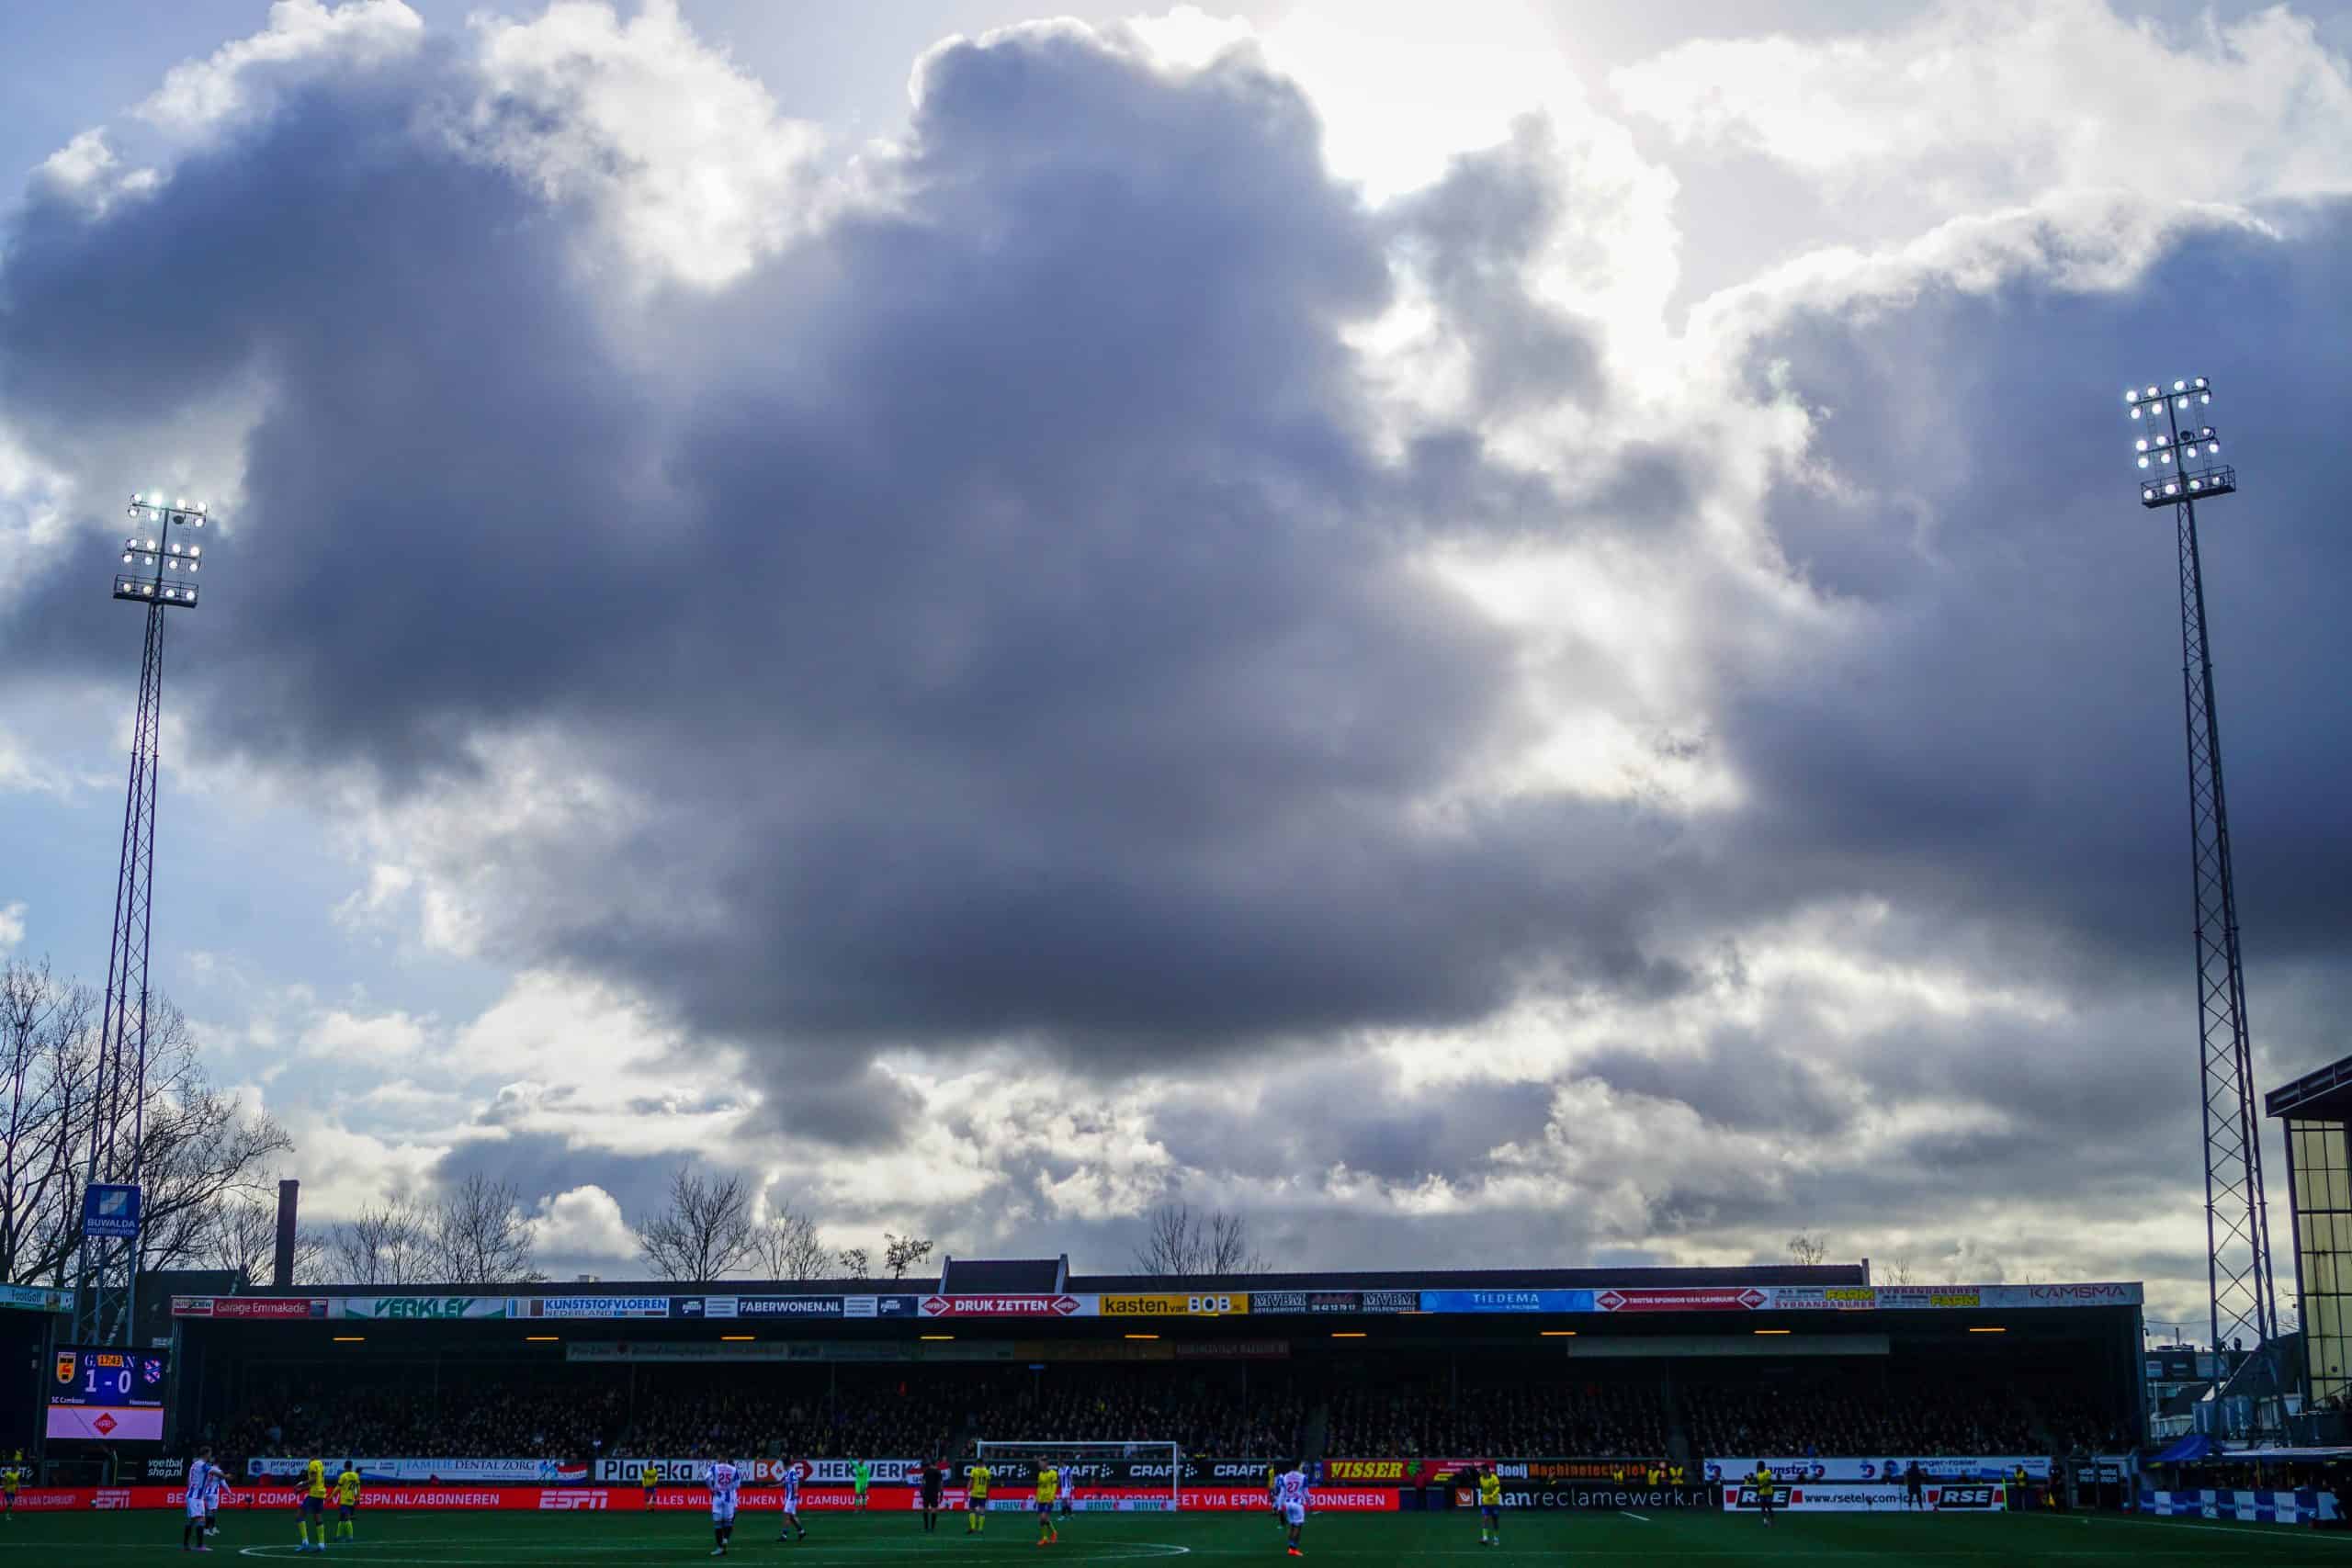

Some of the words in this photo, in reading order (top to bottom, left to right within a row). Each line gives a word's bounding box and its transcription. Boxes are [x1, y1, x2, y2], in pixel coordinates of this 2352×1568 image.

[87, 1218, 136, 1229] BUWALDA
[2029, 1286, 2125, 1298] KAMSMA
[216, 1301, 251, 1315] Garage
[253, 1302, 307, 1314] Emmakade
[375, 1298, 473, 1318] VERKLEY
[546, 1299, 668, 1310] KUNSTSTOFVLOEREN
[740, 1300, 841, 1314] FABERWONEN.NL
[956, 1300, 994, 1312] DRUK
[997, 1299, 1048, 1312] ZETTEN
[1105, 1297, 1168, 1314] kasten
[1188, 1296, 1231, 1313] BOB
[85, 1369, 96, 1393] 1
[118, 1369, 131, 1394] 0
[147, 1466, 183, 1478] shop.nl
[456, 1461, 500, 1471] DENTAL
[503, 1461, 536, 1471] ZORG
[963, 1464, 1017, 1477] CAFT
[1130, 1464, 1183, 1477] CRAFT
[1215, 1464, 1268, 1477] CRAFT
[1330, 1461, 1404, 1479] VISSER
[718, 1472, 732, 1484] 25
[1287, 1481, 1300, 1493] 27
[538, 1490, 610, 1509] ESPN
[1204, 1494, 1228, 1506] VIA
[1743, 1489, 1787, 1503] RE
[1943, 1488, 1990, 1503] RSE
